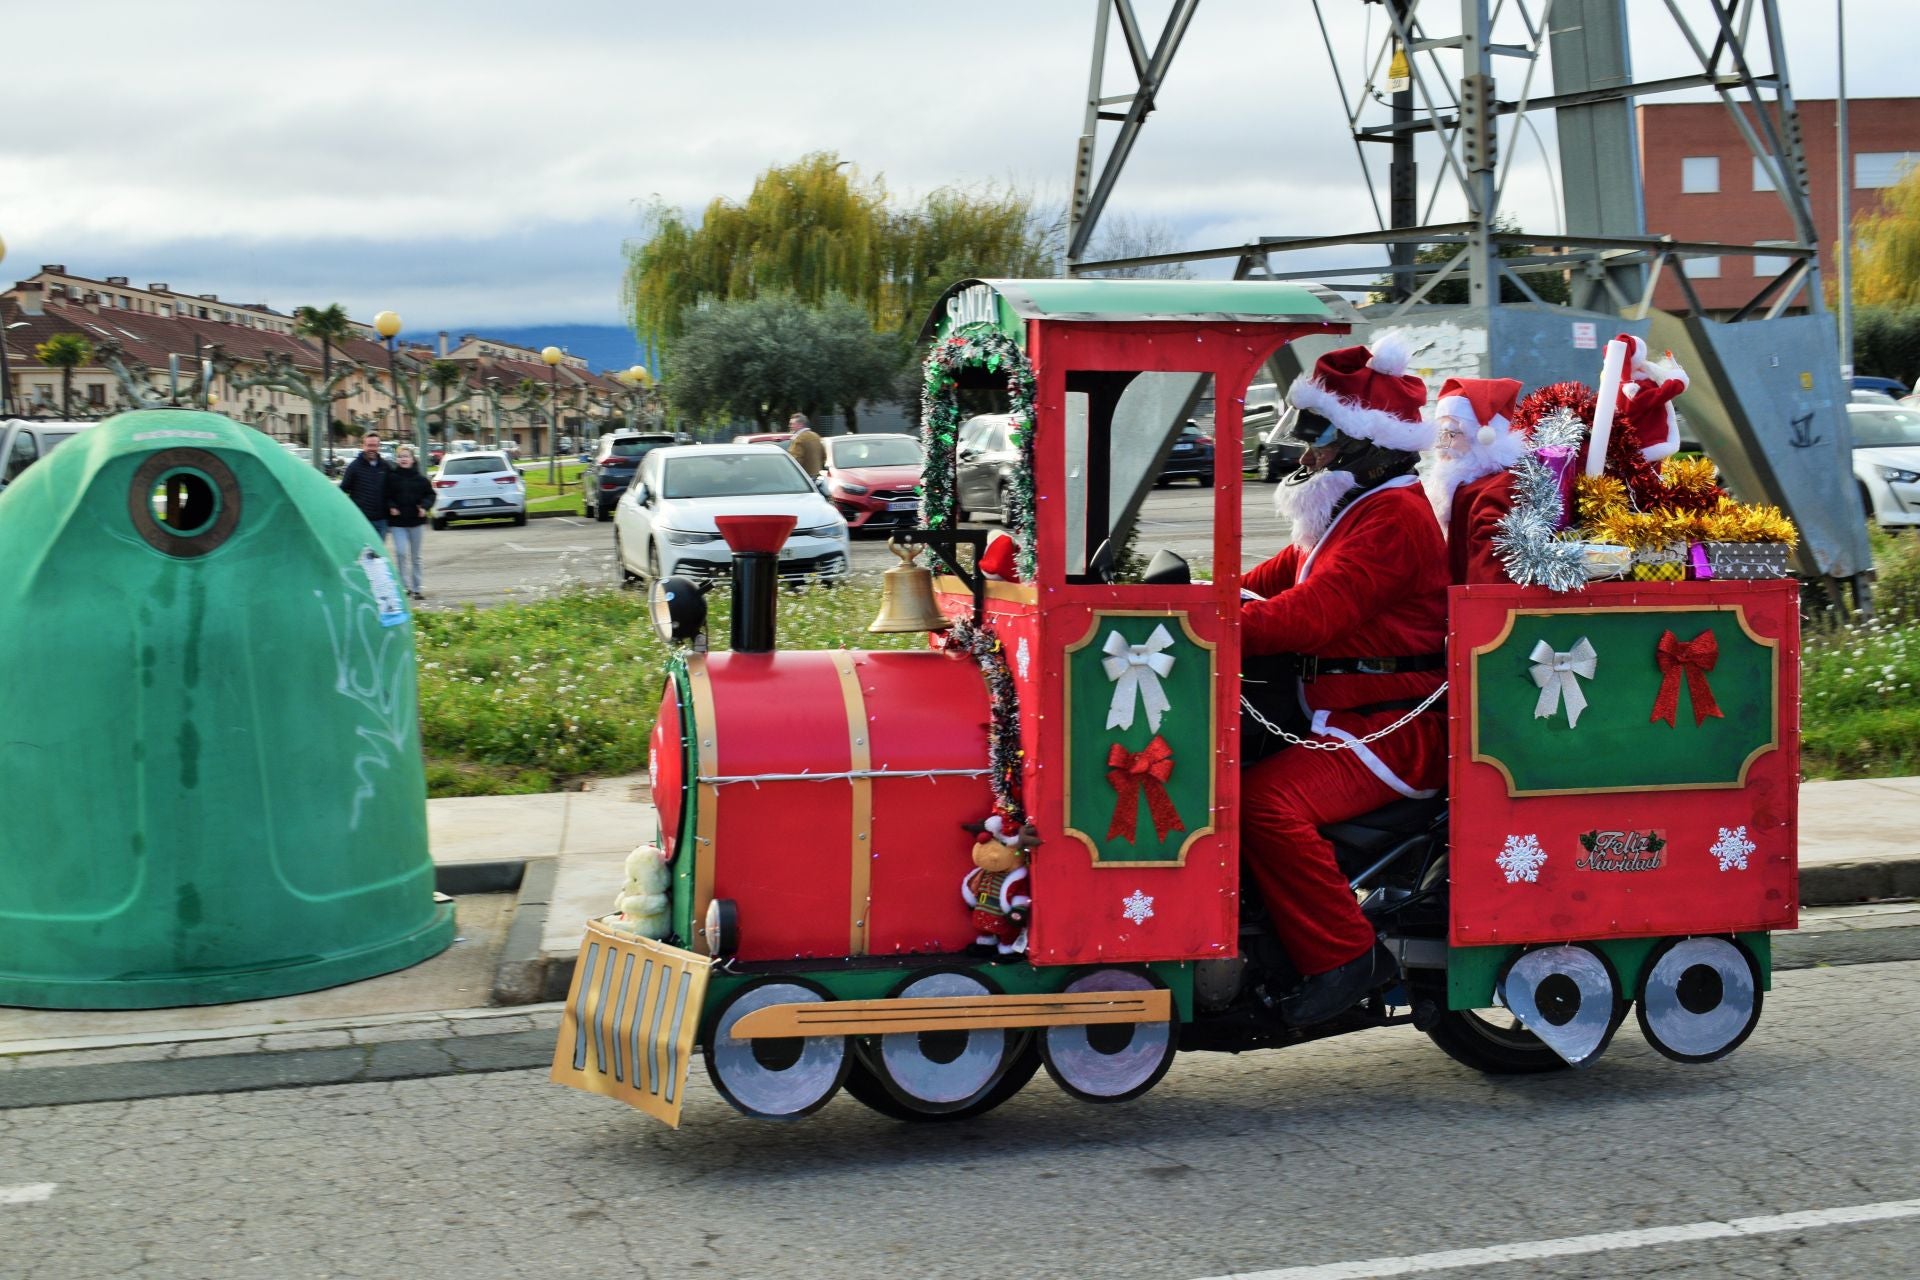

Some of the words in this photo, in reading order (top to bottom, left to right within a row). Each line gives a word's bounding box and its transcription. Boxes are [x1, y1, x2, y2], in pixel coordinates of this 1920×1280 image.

[946, 284, 998, 335] SANTA
[1595, 830, 1650, 855] Feliz
[1576, 847, 1661, 872] Navidad
